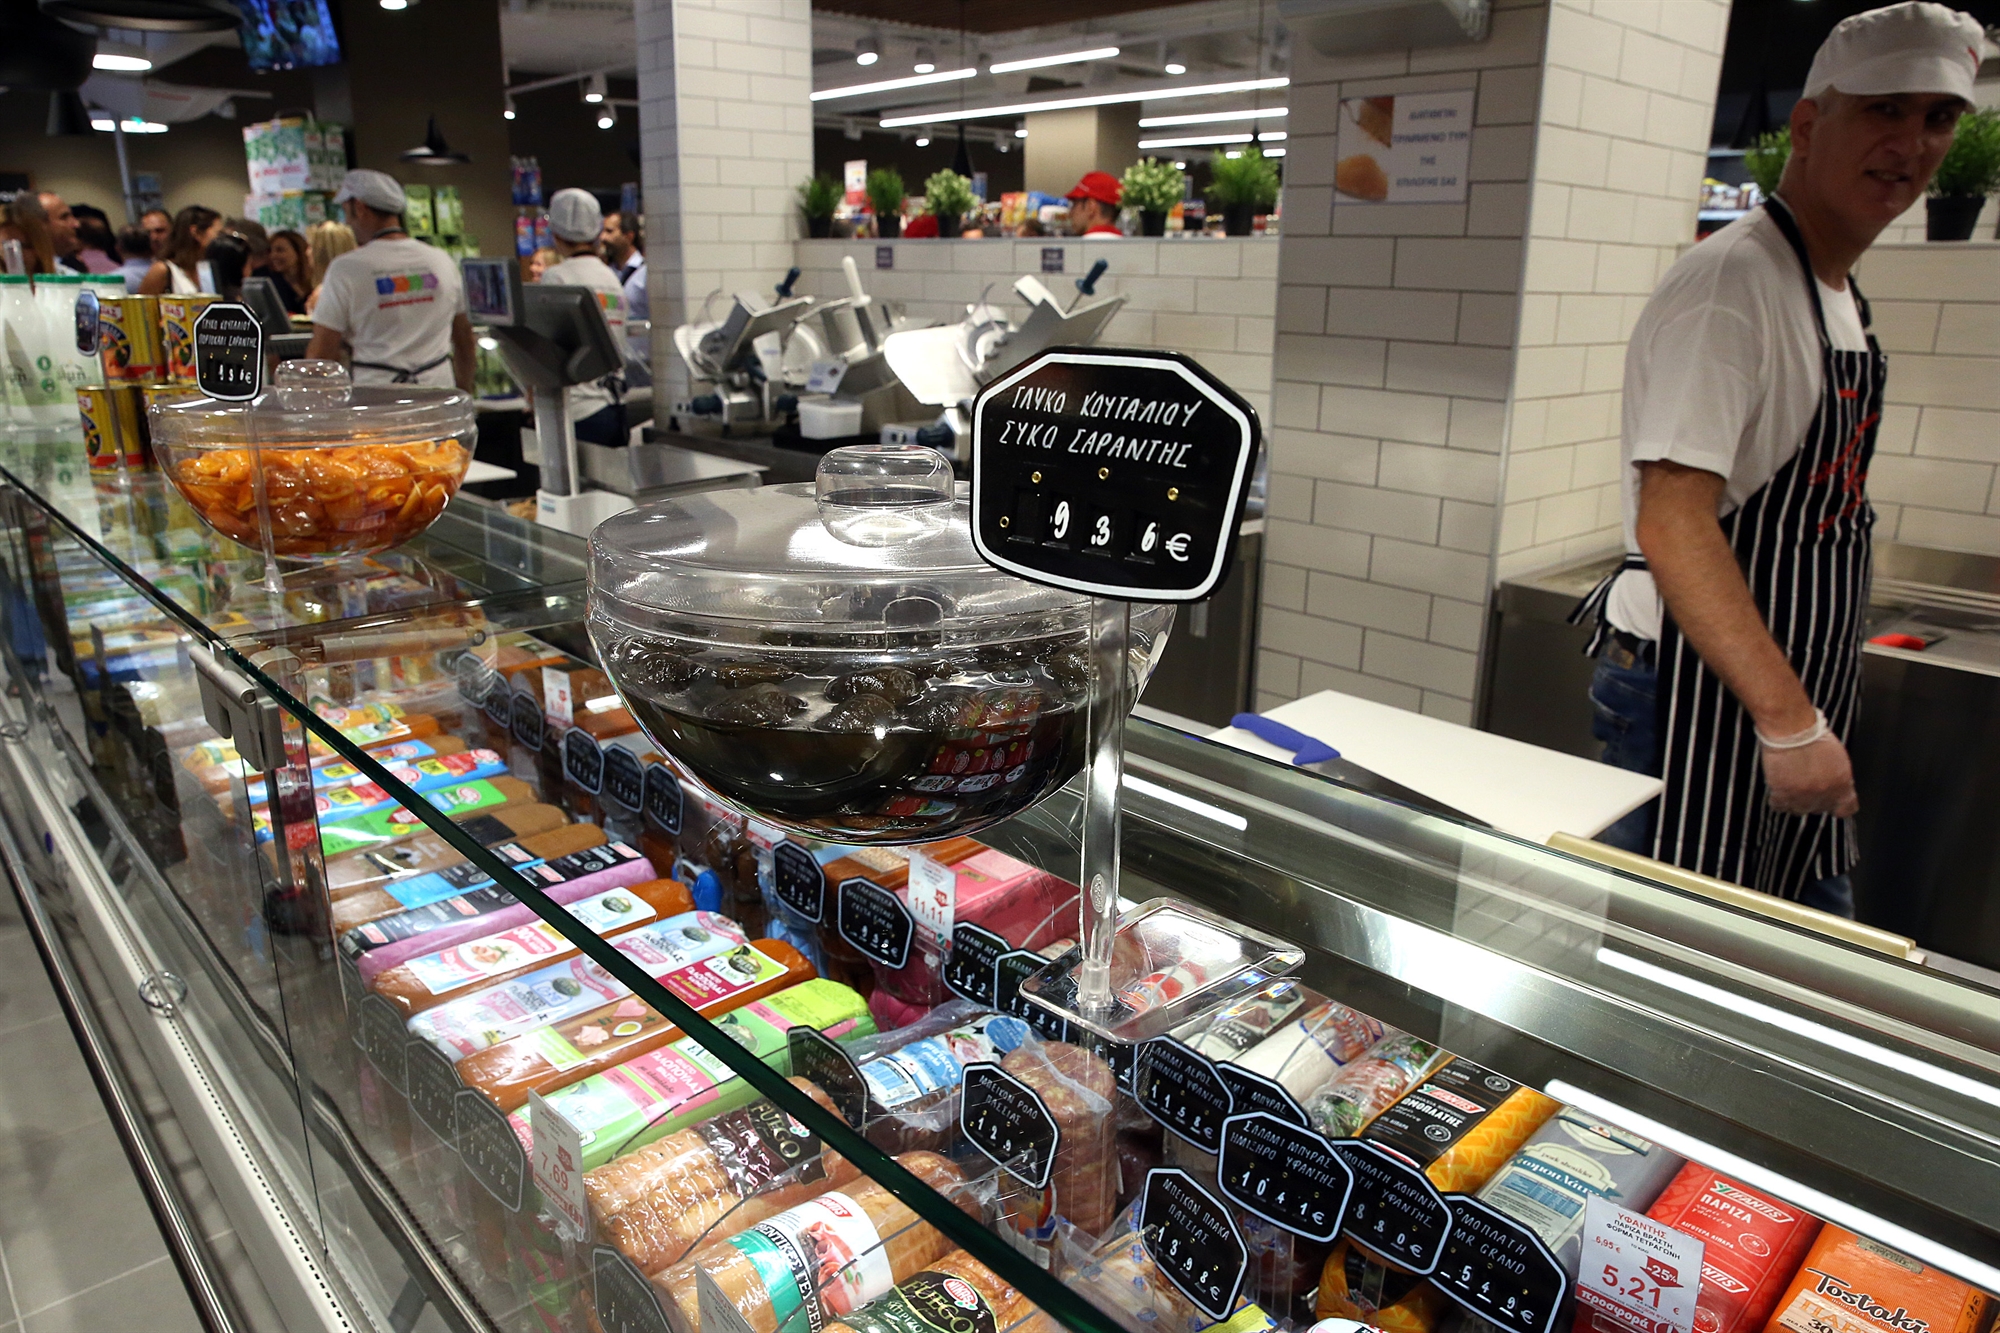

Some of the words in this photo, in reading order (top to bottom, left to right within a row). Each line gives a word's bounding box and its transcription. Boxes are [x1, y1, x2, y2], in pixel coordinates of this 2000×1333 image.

[1012, 385, 1067, 414] ΓΛΥΚΟ
[1080, 390, 1202, 427] ΚΟΥΤΑΛΙΟΥ
[999, 420, 1058, 449] ΣΥΚΟ
[1067, 428, 1192, 468] ΣΑΡΑΝΤΗΣ
[1185, 1065, 1211, 1087] ΑΕΡΟΣ
[1187, 1081, 1224, 1110] ΥΦΑΝΤΗΣ
[979, 1075, 1015, 1104] ΜΠΕΙΚΟΝ
[1017, 1100, 1038, 1120] ΡΟΛΟ
[1251, 1090, 1287, 1115] ΜΠΥΡΑΣ
[1401, 1098, 1463, 1128] ΩΜΟΠΛΑΤΗΣ
[751, 1104, 800, 1158] FUEGO
[1243, 1120, 1286, 1147] ΣΑΛΑΜΙ
[1287, 1142, 1332, 1169] ΜΠΥΡΑΣ
[1286, 1156, 1336, 1188] ΥΦΑΝΤΗΣ
[1163, 1178, 1201, 1215] ΜΠΕΙΚΟΝ
[1202, 1212, 1230, 1241] ΠΛΑΚΑ
[1382, 1189, 1432, 1228] ΥΦΑΝΤΗΣ
[1393, 1180, 1437, 1211] ΧΟΙΡΙΝΗ
[1700, 1194, 1752, 1224] ΠΑΡΙΖΑ
[1168, 1203, 1210, 1245] ΠΑΣΣΙΑΣ
[1606, 1223, 1633, 1239] ΦΟΡΜΑ
[1635, 1236, 1681, 1260] ΤΕΤΡΑΓΩΝΗ
[1614, 1220, 1641, 1236] ΠΑΡΙΖΑ
[1643, 1232, 1673, 1249] ΒΡΑΣΤΗ
[1618, 1212, 1667, 1239] ΥΦΑΝΤΗΣ
[1453, 1228, 1475, 1246] MR
[1480, 1244, 1525, 1275] GRAND
[1602, 1264, 1662, 1309] 5,21
[1646, 1264, 1677, 1283] -25%
[901, 1281, 974, 1333] FUEGO
[1581, 1290, 1650, 1329] προσφορά
